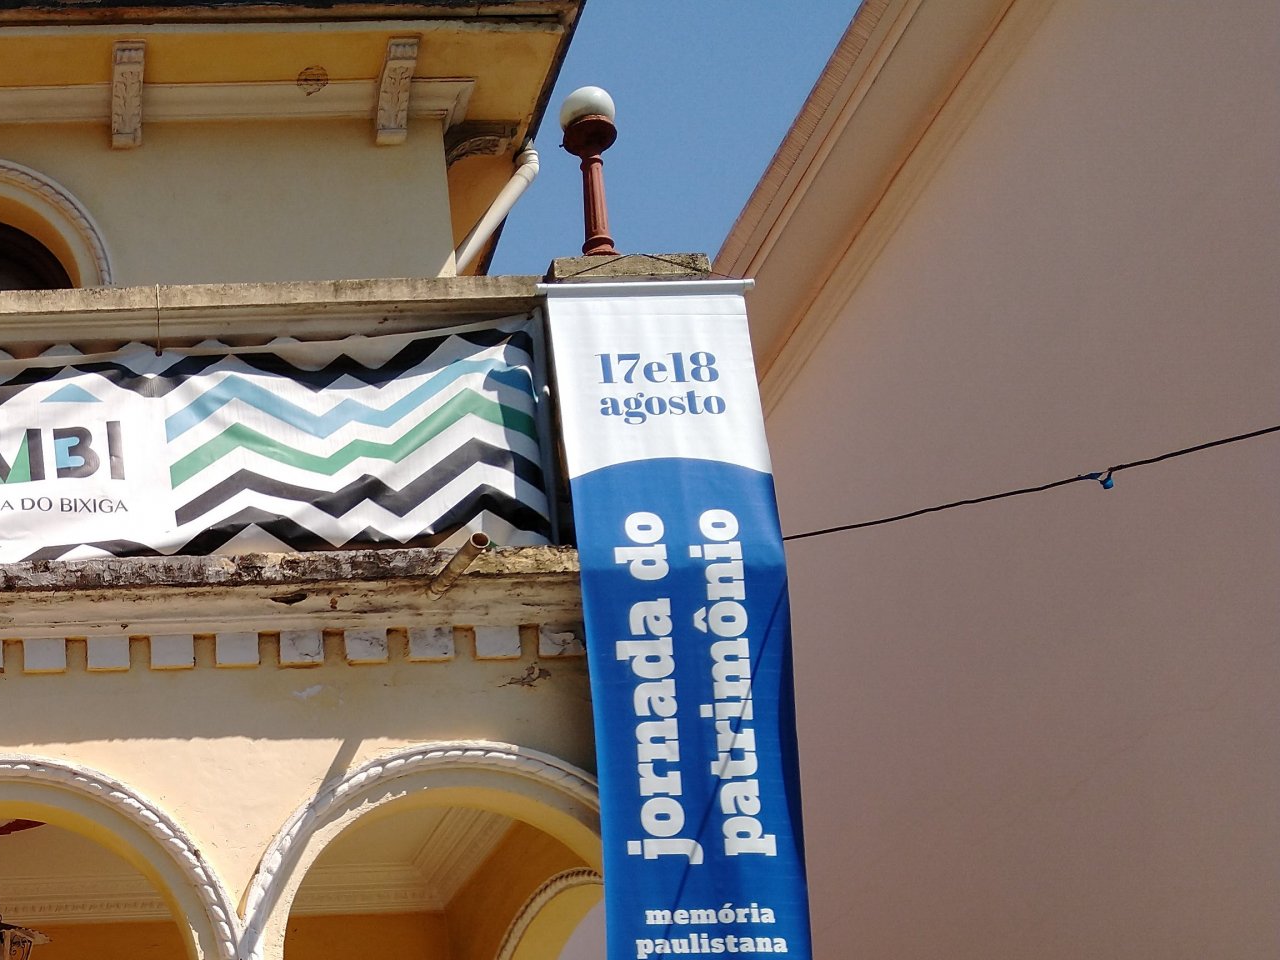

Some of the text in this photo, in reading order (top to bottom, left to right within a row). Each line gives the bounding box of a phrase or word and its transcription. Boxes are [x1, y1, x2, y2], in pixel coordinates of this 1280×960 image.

[593, 351, 720, 385] 17e18
[599, 389, 727, 426] agosto
[21, 497, 53, 513] DO
[60, 497, 128, 514] BIXIGA
[614, 511, 704, 865] jornada do
[689, 508, 777, 858] patrimônio
[645, 902, 776, 926] memória
[635, 933, 788, 960] paulistana
